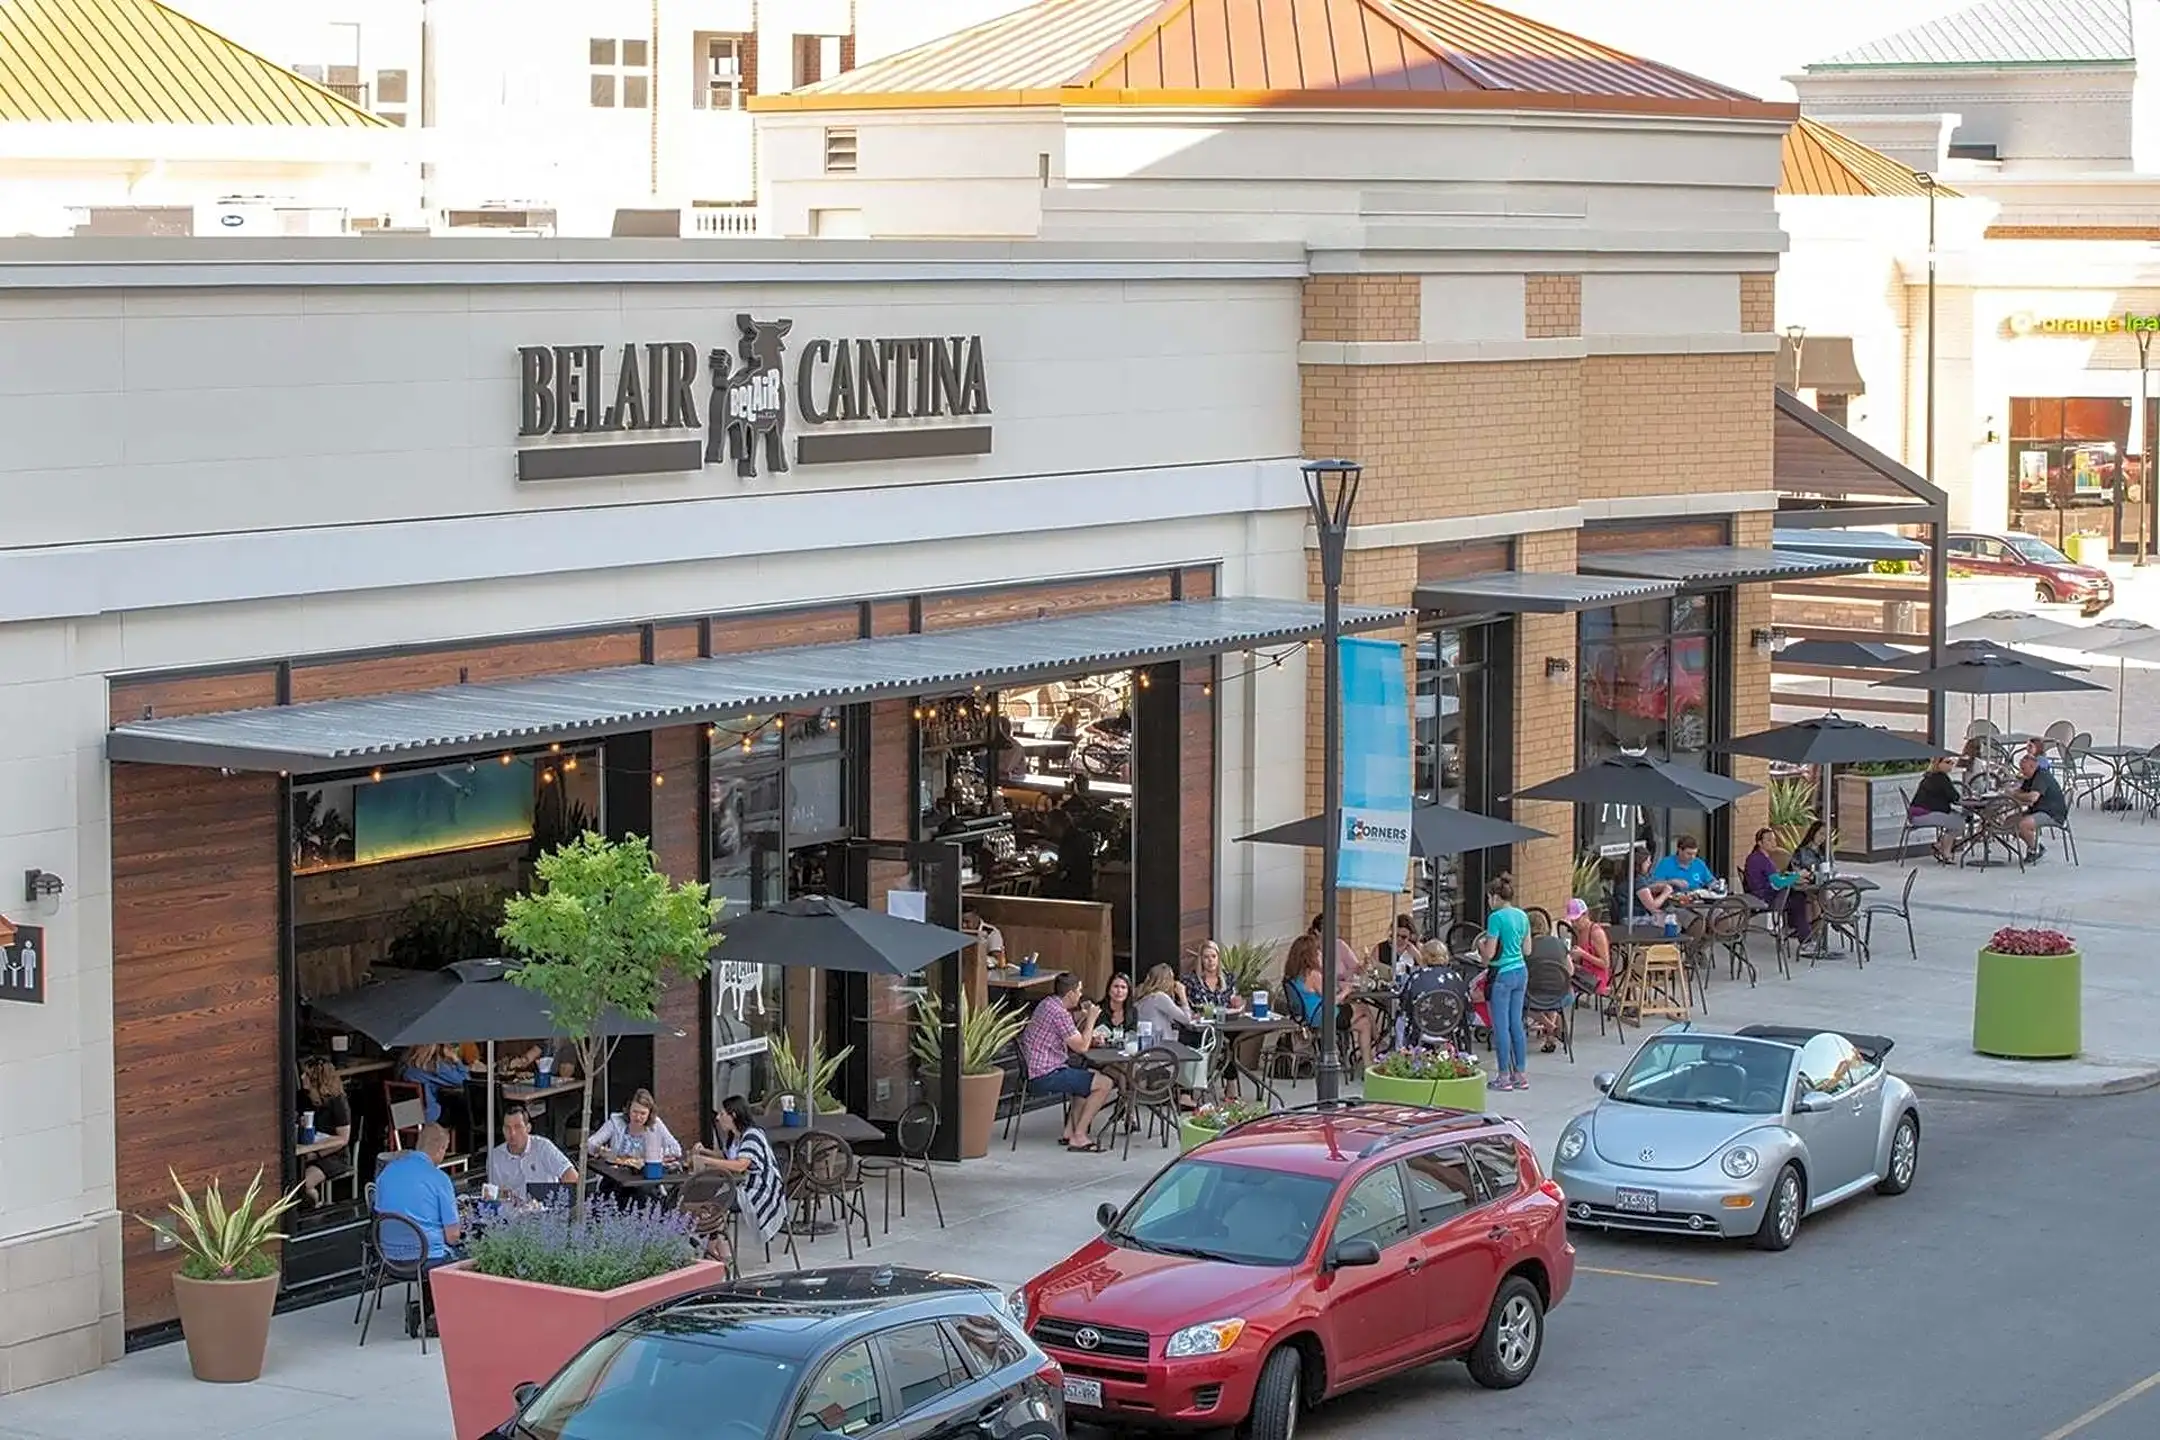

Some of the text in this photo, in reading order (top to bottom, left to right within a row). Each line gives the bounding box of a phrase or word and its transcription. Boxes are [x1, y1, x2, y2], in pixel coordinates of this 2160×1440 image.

[2041, 311, 2160, 335] orange lea
[518, 335, 993, 437] BELAIR CANTINA
[1351, 823, 1408, 841] CORNERS
